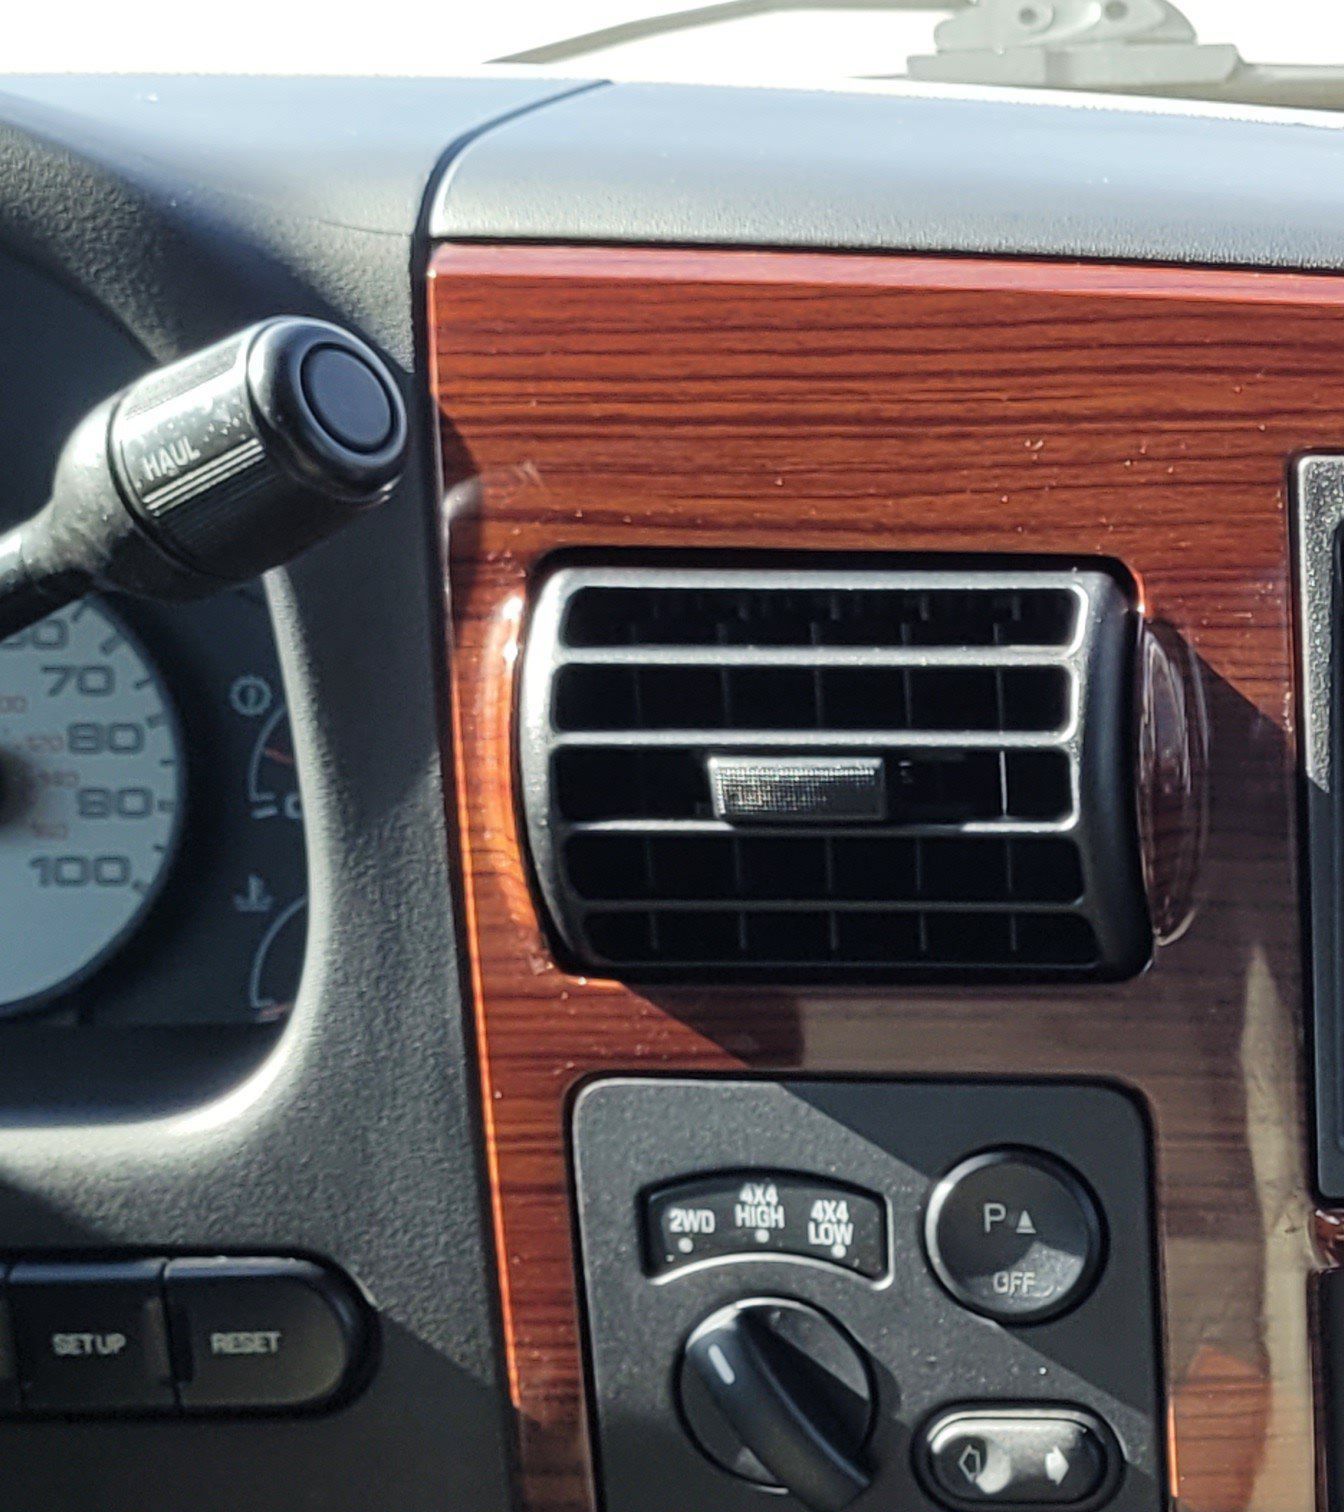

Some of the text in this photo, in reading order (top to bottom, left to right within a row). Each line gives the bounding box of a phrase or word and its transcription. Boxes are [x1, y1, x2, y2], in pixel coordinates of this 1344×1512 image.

[142, 436, 201, 481] HAUL
[41, 664, 115, 697] 70
[67, 722, 145, 755] 80
[29, 855, 131, 887] 100
[739, 1183, 779, 1205] 4X4
[669, 1208, 715, 1233] 2WD
[735, 1204, 785, 1229] HIGH
[810, 1200, 849, 1223] 4X4
[984, 1203, 1006, 1233] P
[808, 1221, 854, 1246] LOW
[993, 1271, 1036, 1297] OFF
[210, 1331, 281, 1354] RESET
